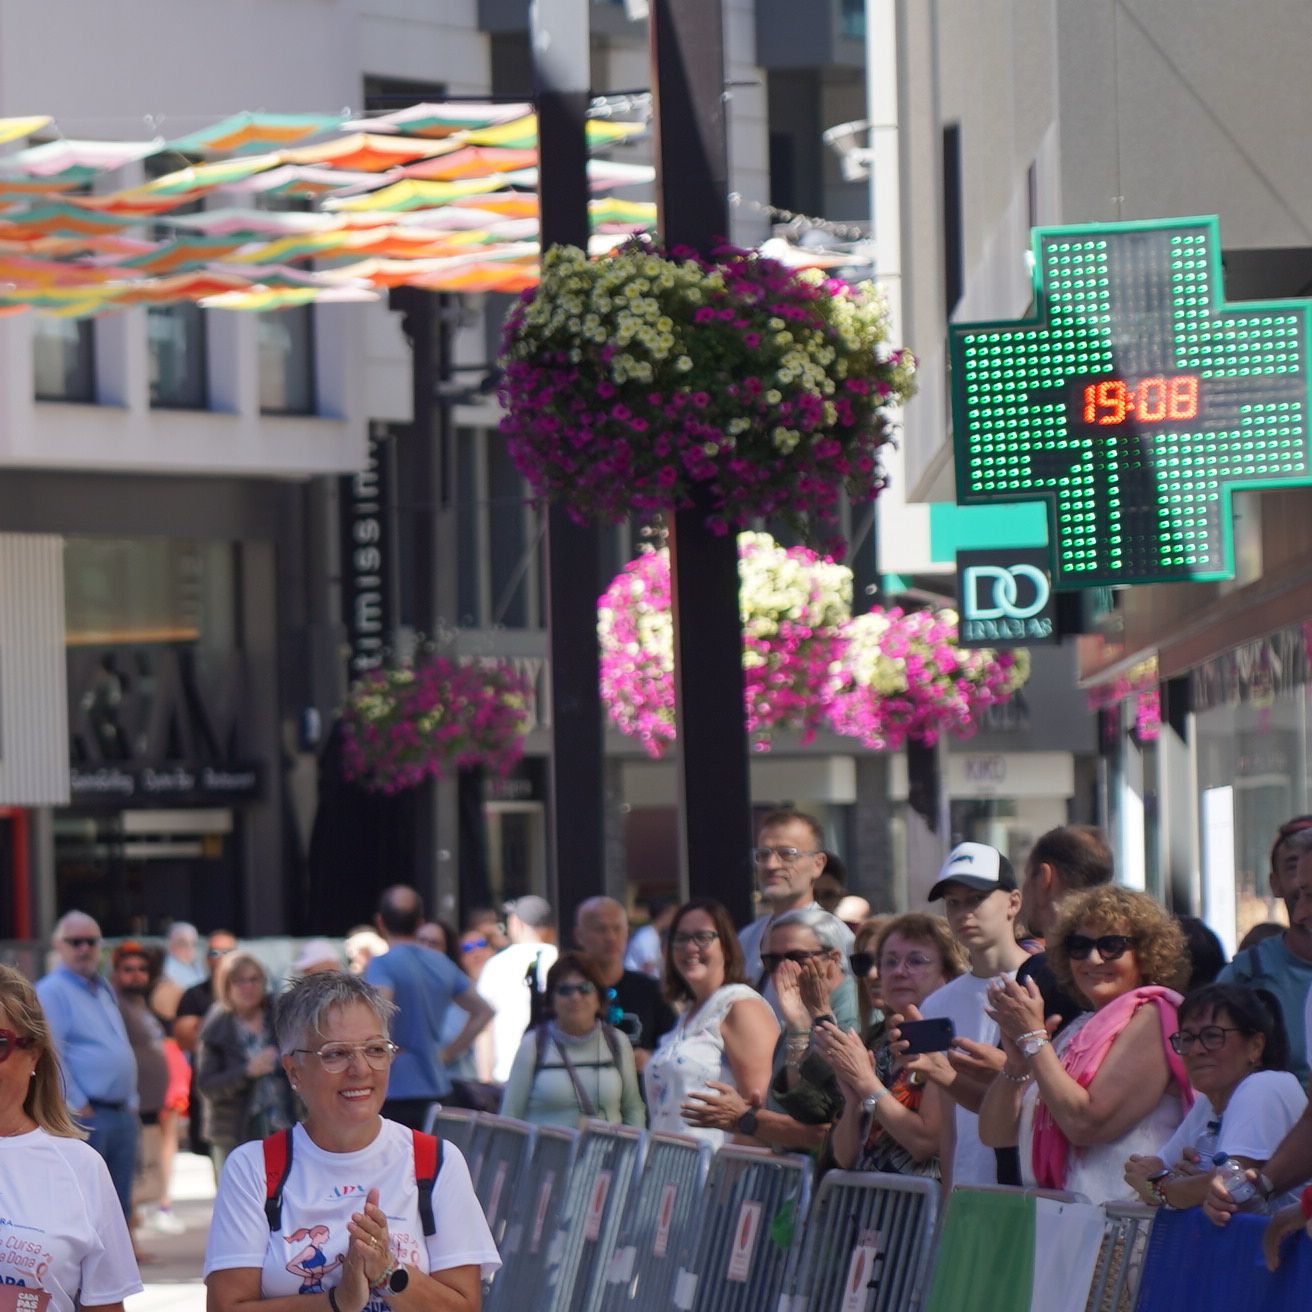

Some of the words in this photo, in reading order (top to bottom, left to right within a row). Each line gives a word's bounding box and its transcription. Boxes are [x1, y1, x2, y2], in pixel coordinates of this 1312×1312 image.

[1084, 376, 1198, 425] 19:08
[5, 1235, 42, 1255] Cursa
[6, 1250, 37, 1269] Dona
[16, 1300, 38, 1310] PAS
[18, 1292, 39, 1301] CADA
